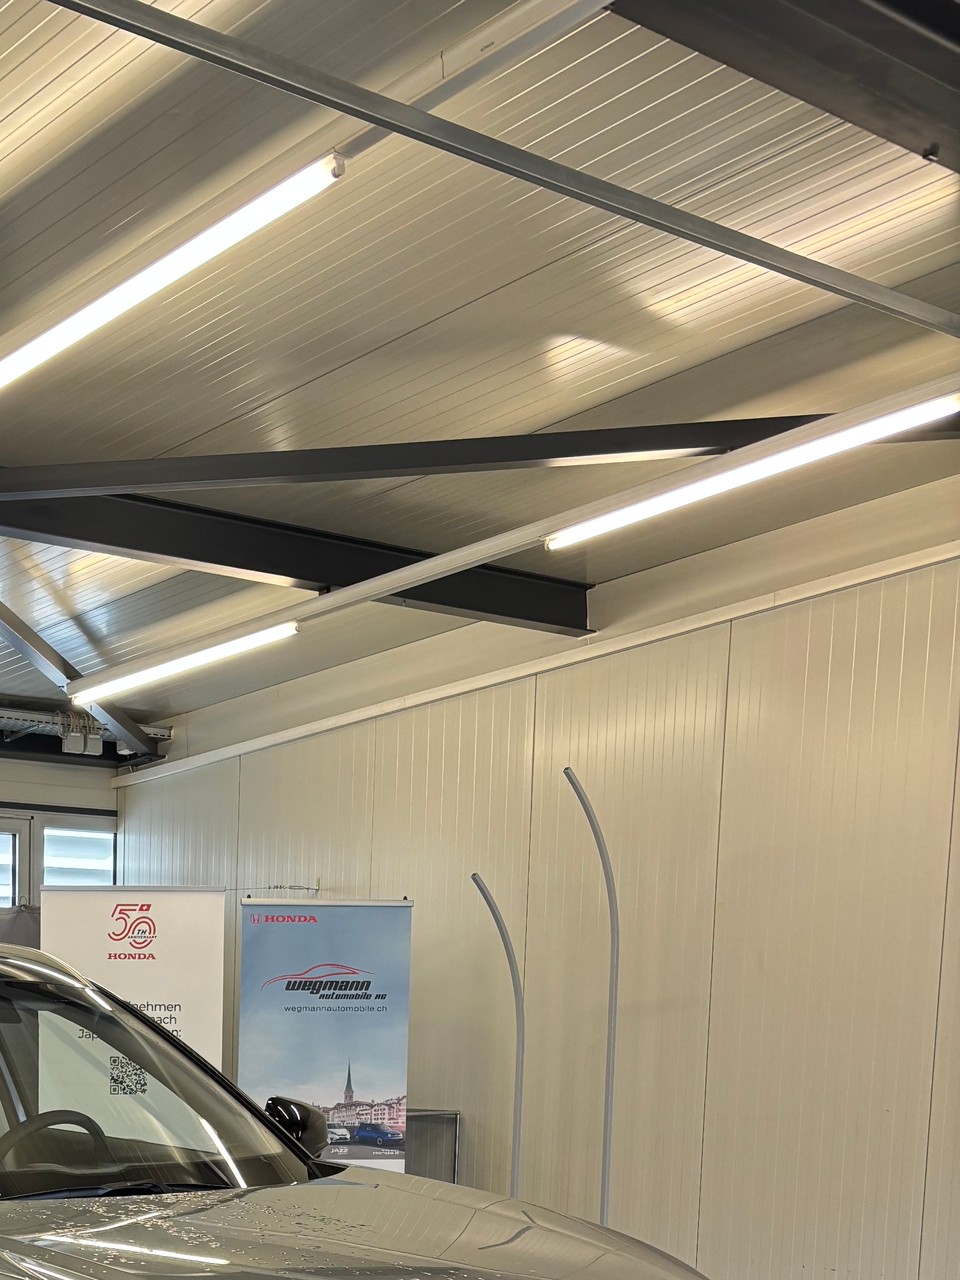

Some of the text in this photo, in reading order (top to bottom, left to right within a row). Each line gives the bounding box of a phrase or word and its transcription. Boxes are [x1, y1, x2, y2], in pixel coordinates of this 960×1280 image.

[263, 914, 318, 923] HONDA
[285, 980, 372, 995] wegmann
[284, 1005, 388, 1013] wegmannautomobile.ch
